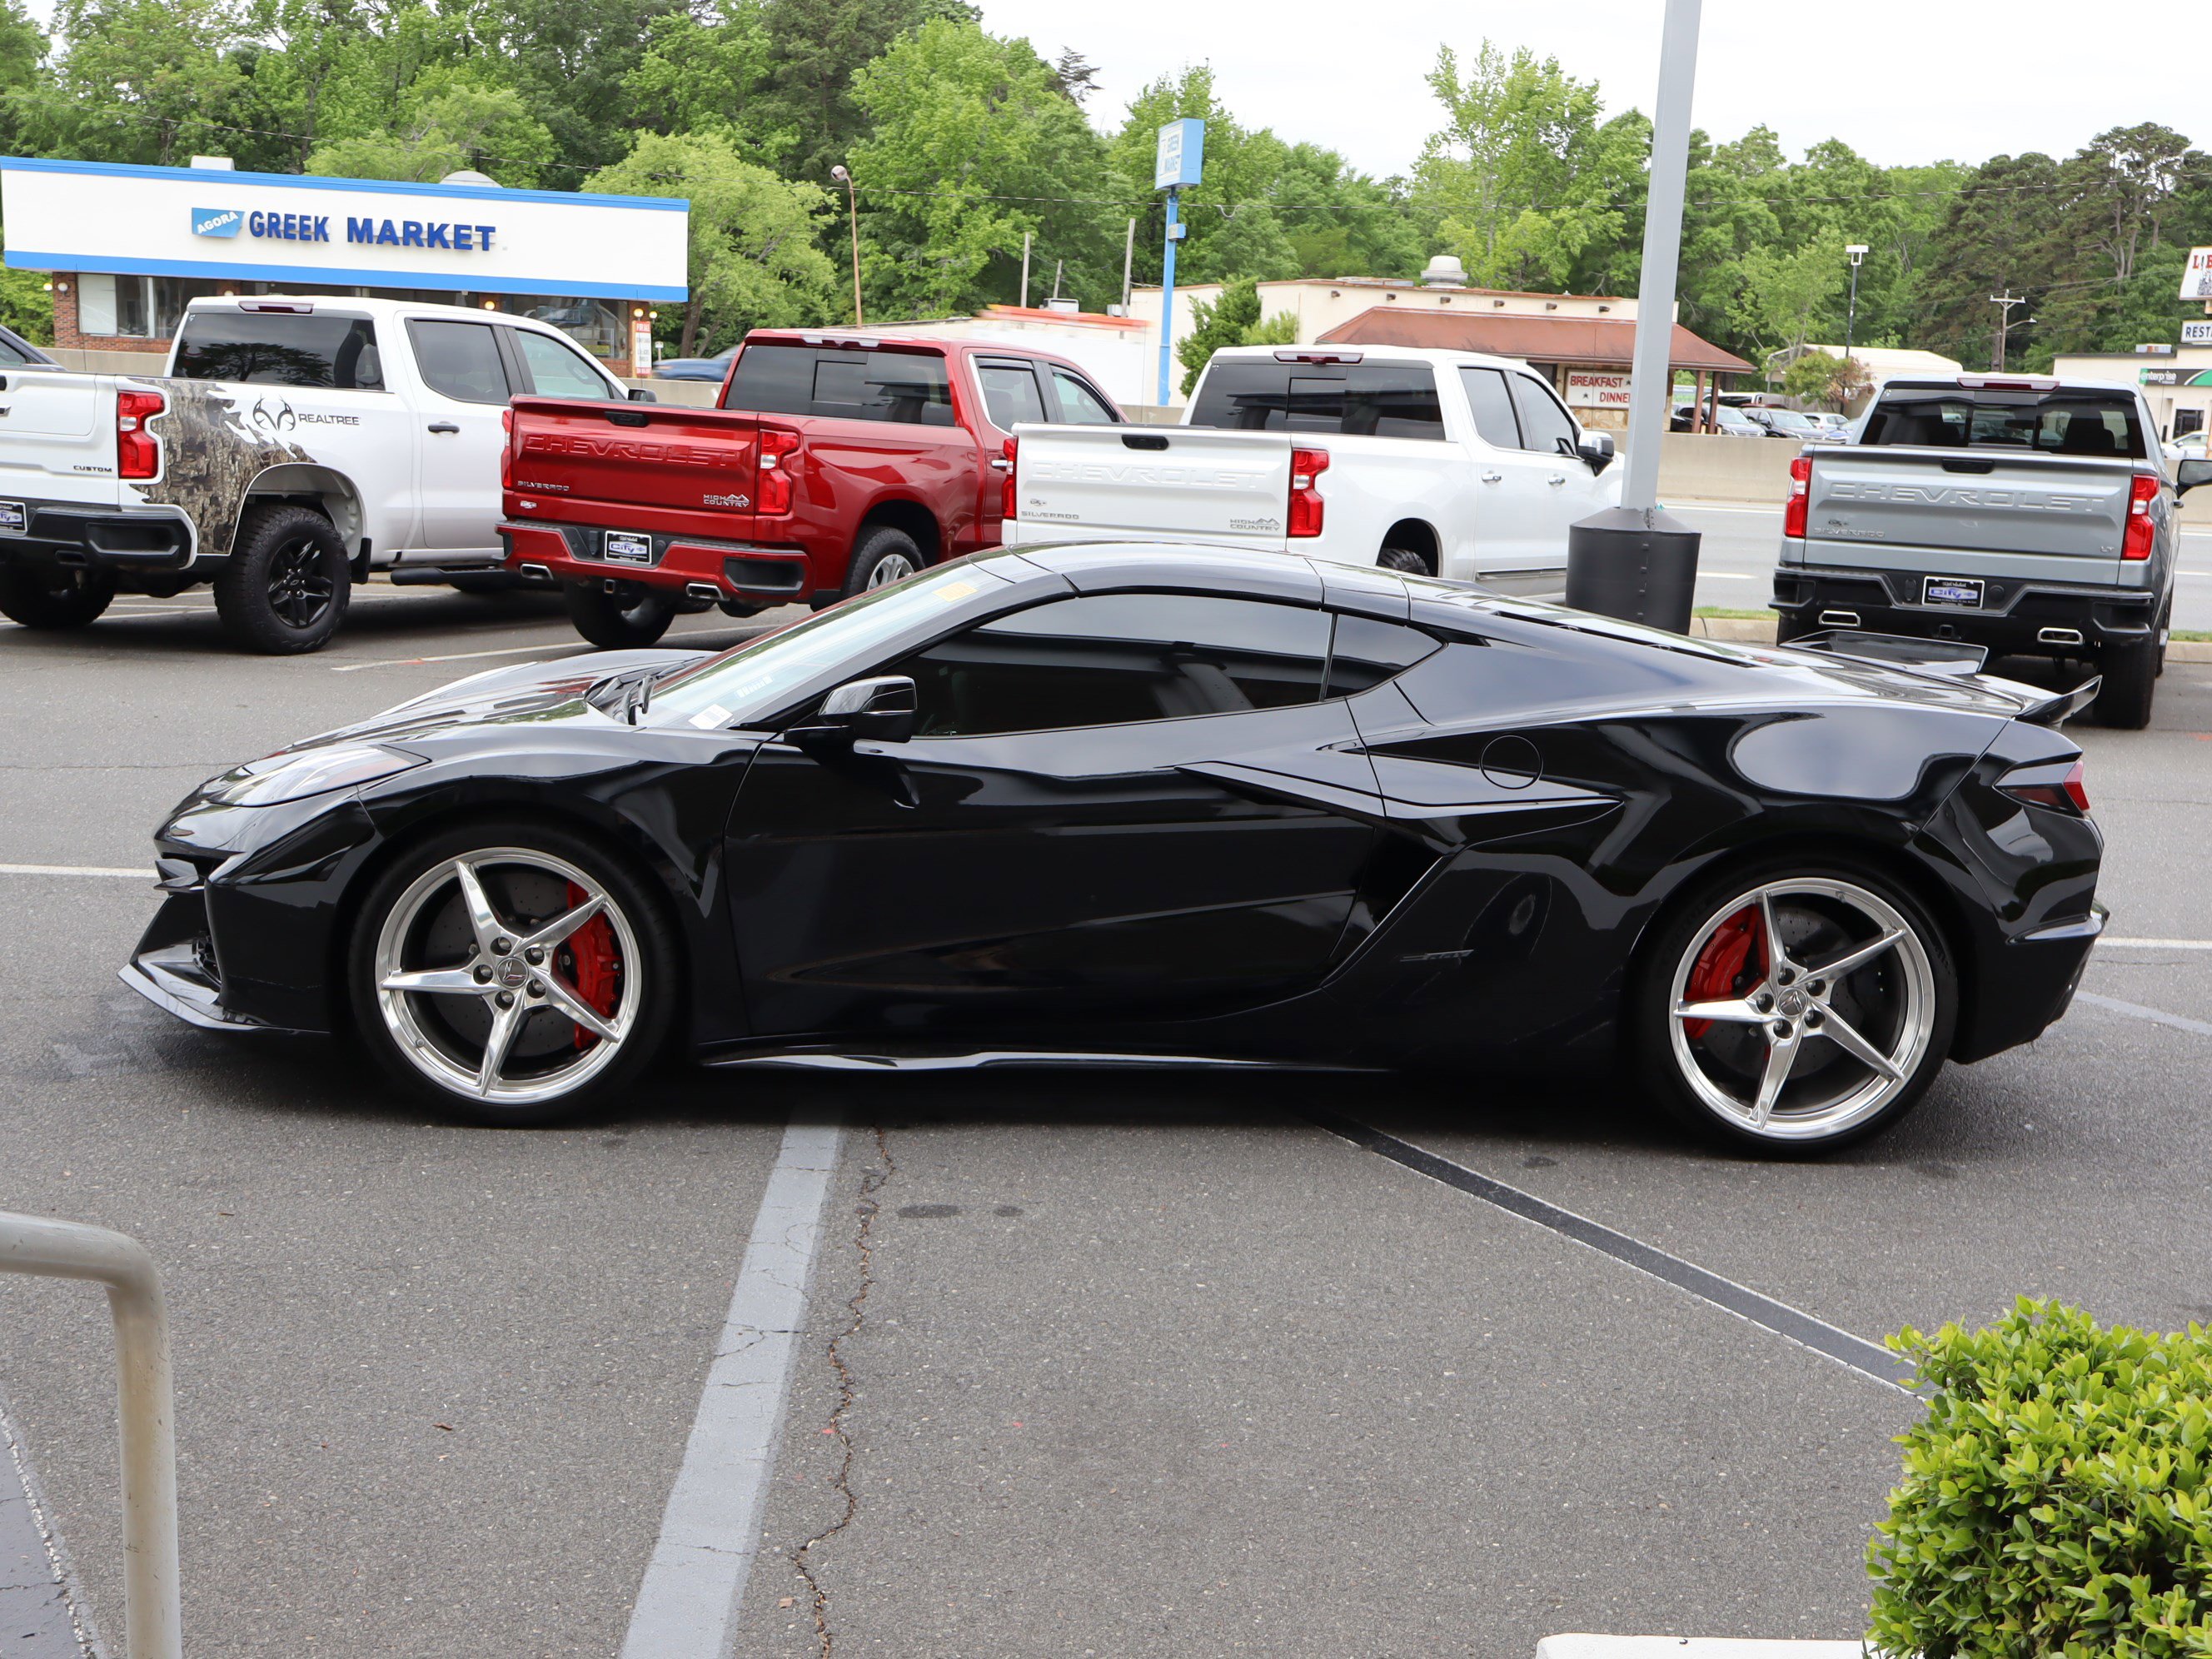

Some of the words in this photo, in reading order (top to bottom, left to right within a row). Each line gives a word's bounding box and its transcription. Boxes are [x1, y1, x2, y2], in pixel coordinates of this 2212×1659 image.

[196, 211, 239, 234] AGORA
[250, 210, 330, 242] GREEK
[346, 216, 496, 252] MARKET
[2185, 326, 2212, 338] REST
[1570, 375, 1623, 388] BREAKFAST
[2140, 370, 2177, 383] enterprise
[298, 412, 360, 426] REALTREE
[526, 434, 738, 466] CHEVROLET
[73, 465, 112, 473] CUSTOM
[1032, 461, 1267, 489] CHEVROLET
[517, 480, 570, 491] SILVERADO
[1830, 481, 2105, 512] CHEVROLET
[703, 499, 750, 508] COUNTRY
[1021, 511, 1080, 520] SILVERADO
[1230, 523, 1279, 531] COUNTRY
